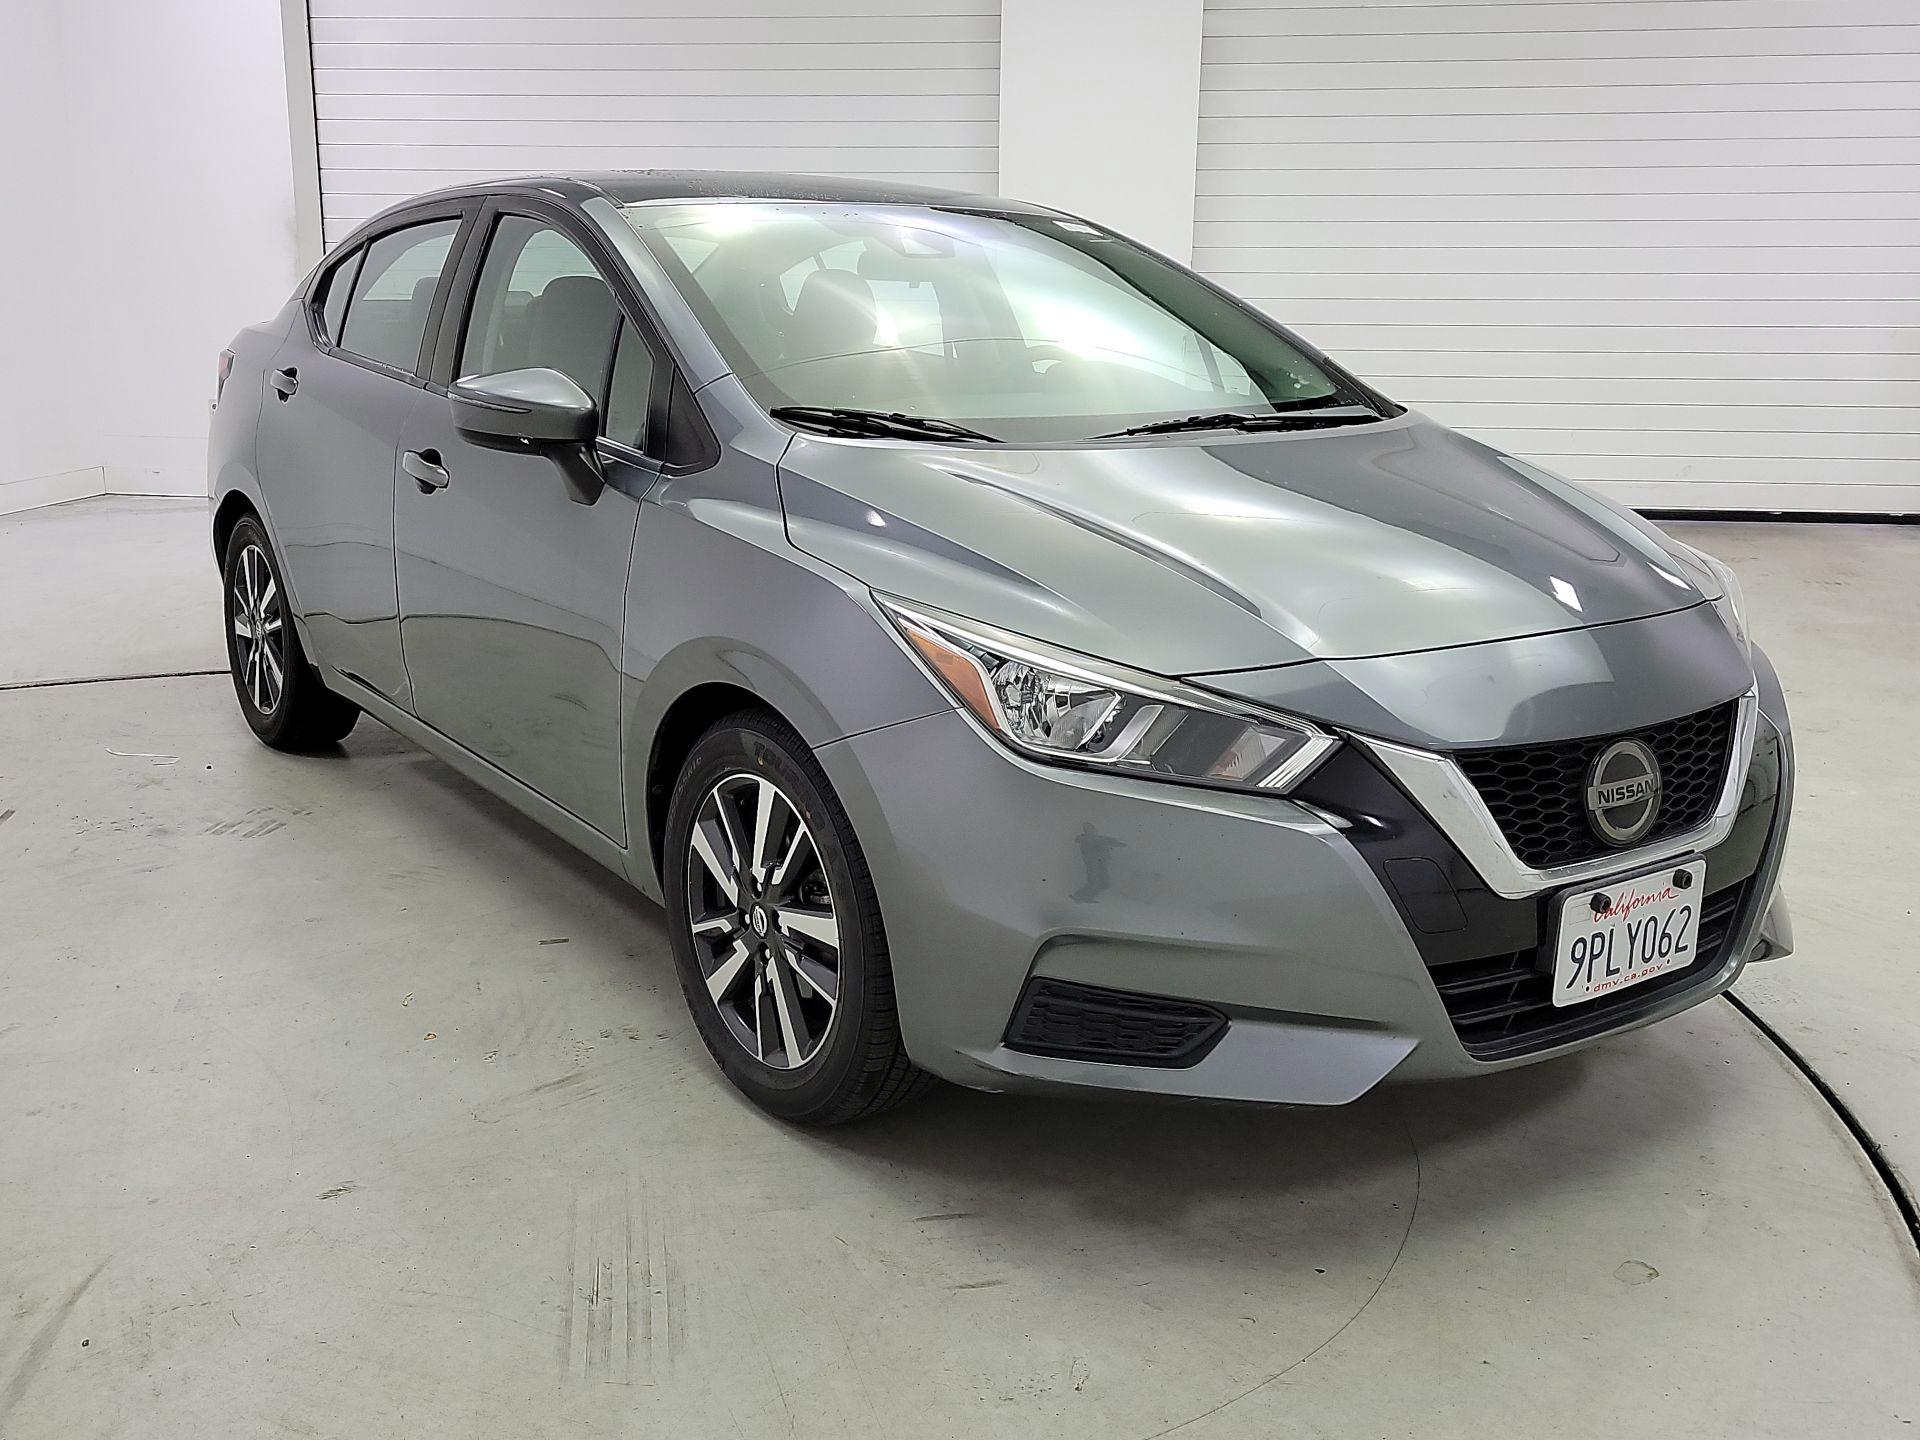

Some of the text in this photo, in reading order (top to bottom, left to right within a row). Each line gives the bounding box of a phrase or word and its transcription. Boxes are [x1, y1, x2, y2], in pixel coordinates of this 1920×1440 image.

[1598, 780, 1654, 804] NISSAN
[1566, 905, 1692, 989] 9PLY062
[1593, 963, 1663, 992] dmv.ca.gov
